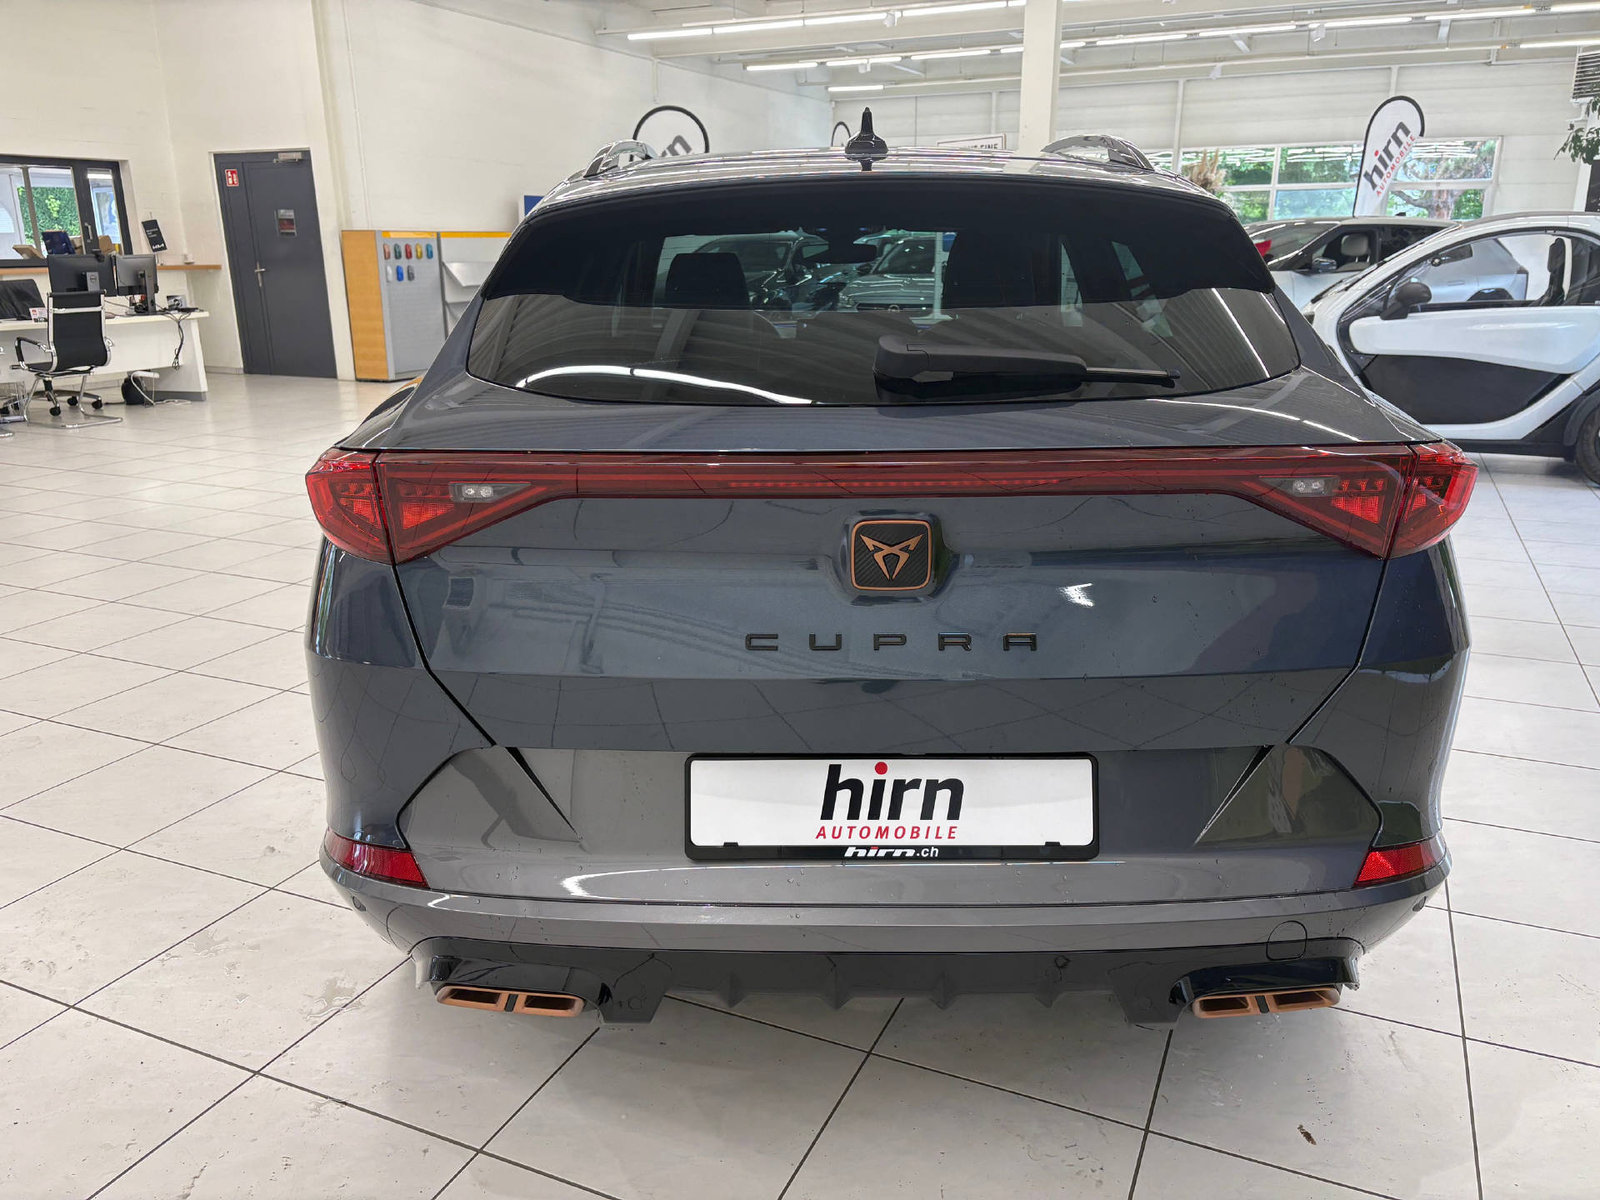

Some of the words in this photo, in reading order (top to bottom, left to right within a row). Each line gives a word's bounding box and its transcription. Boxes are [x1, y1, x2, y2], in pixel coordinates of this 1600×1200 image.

[1363, 121, 1411, 191] hirn
[1376, 135, 1416, 197] AUTOMOBILE
[745, 633, 1037, 651] CUPRA
[820, 761, 965, 821] hirn
[815, 825, 958, 840] AUTOMOBILE
[844, 845, 939, 858] hirn.ch
